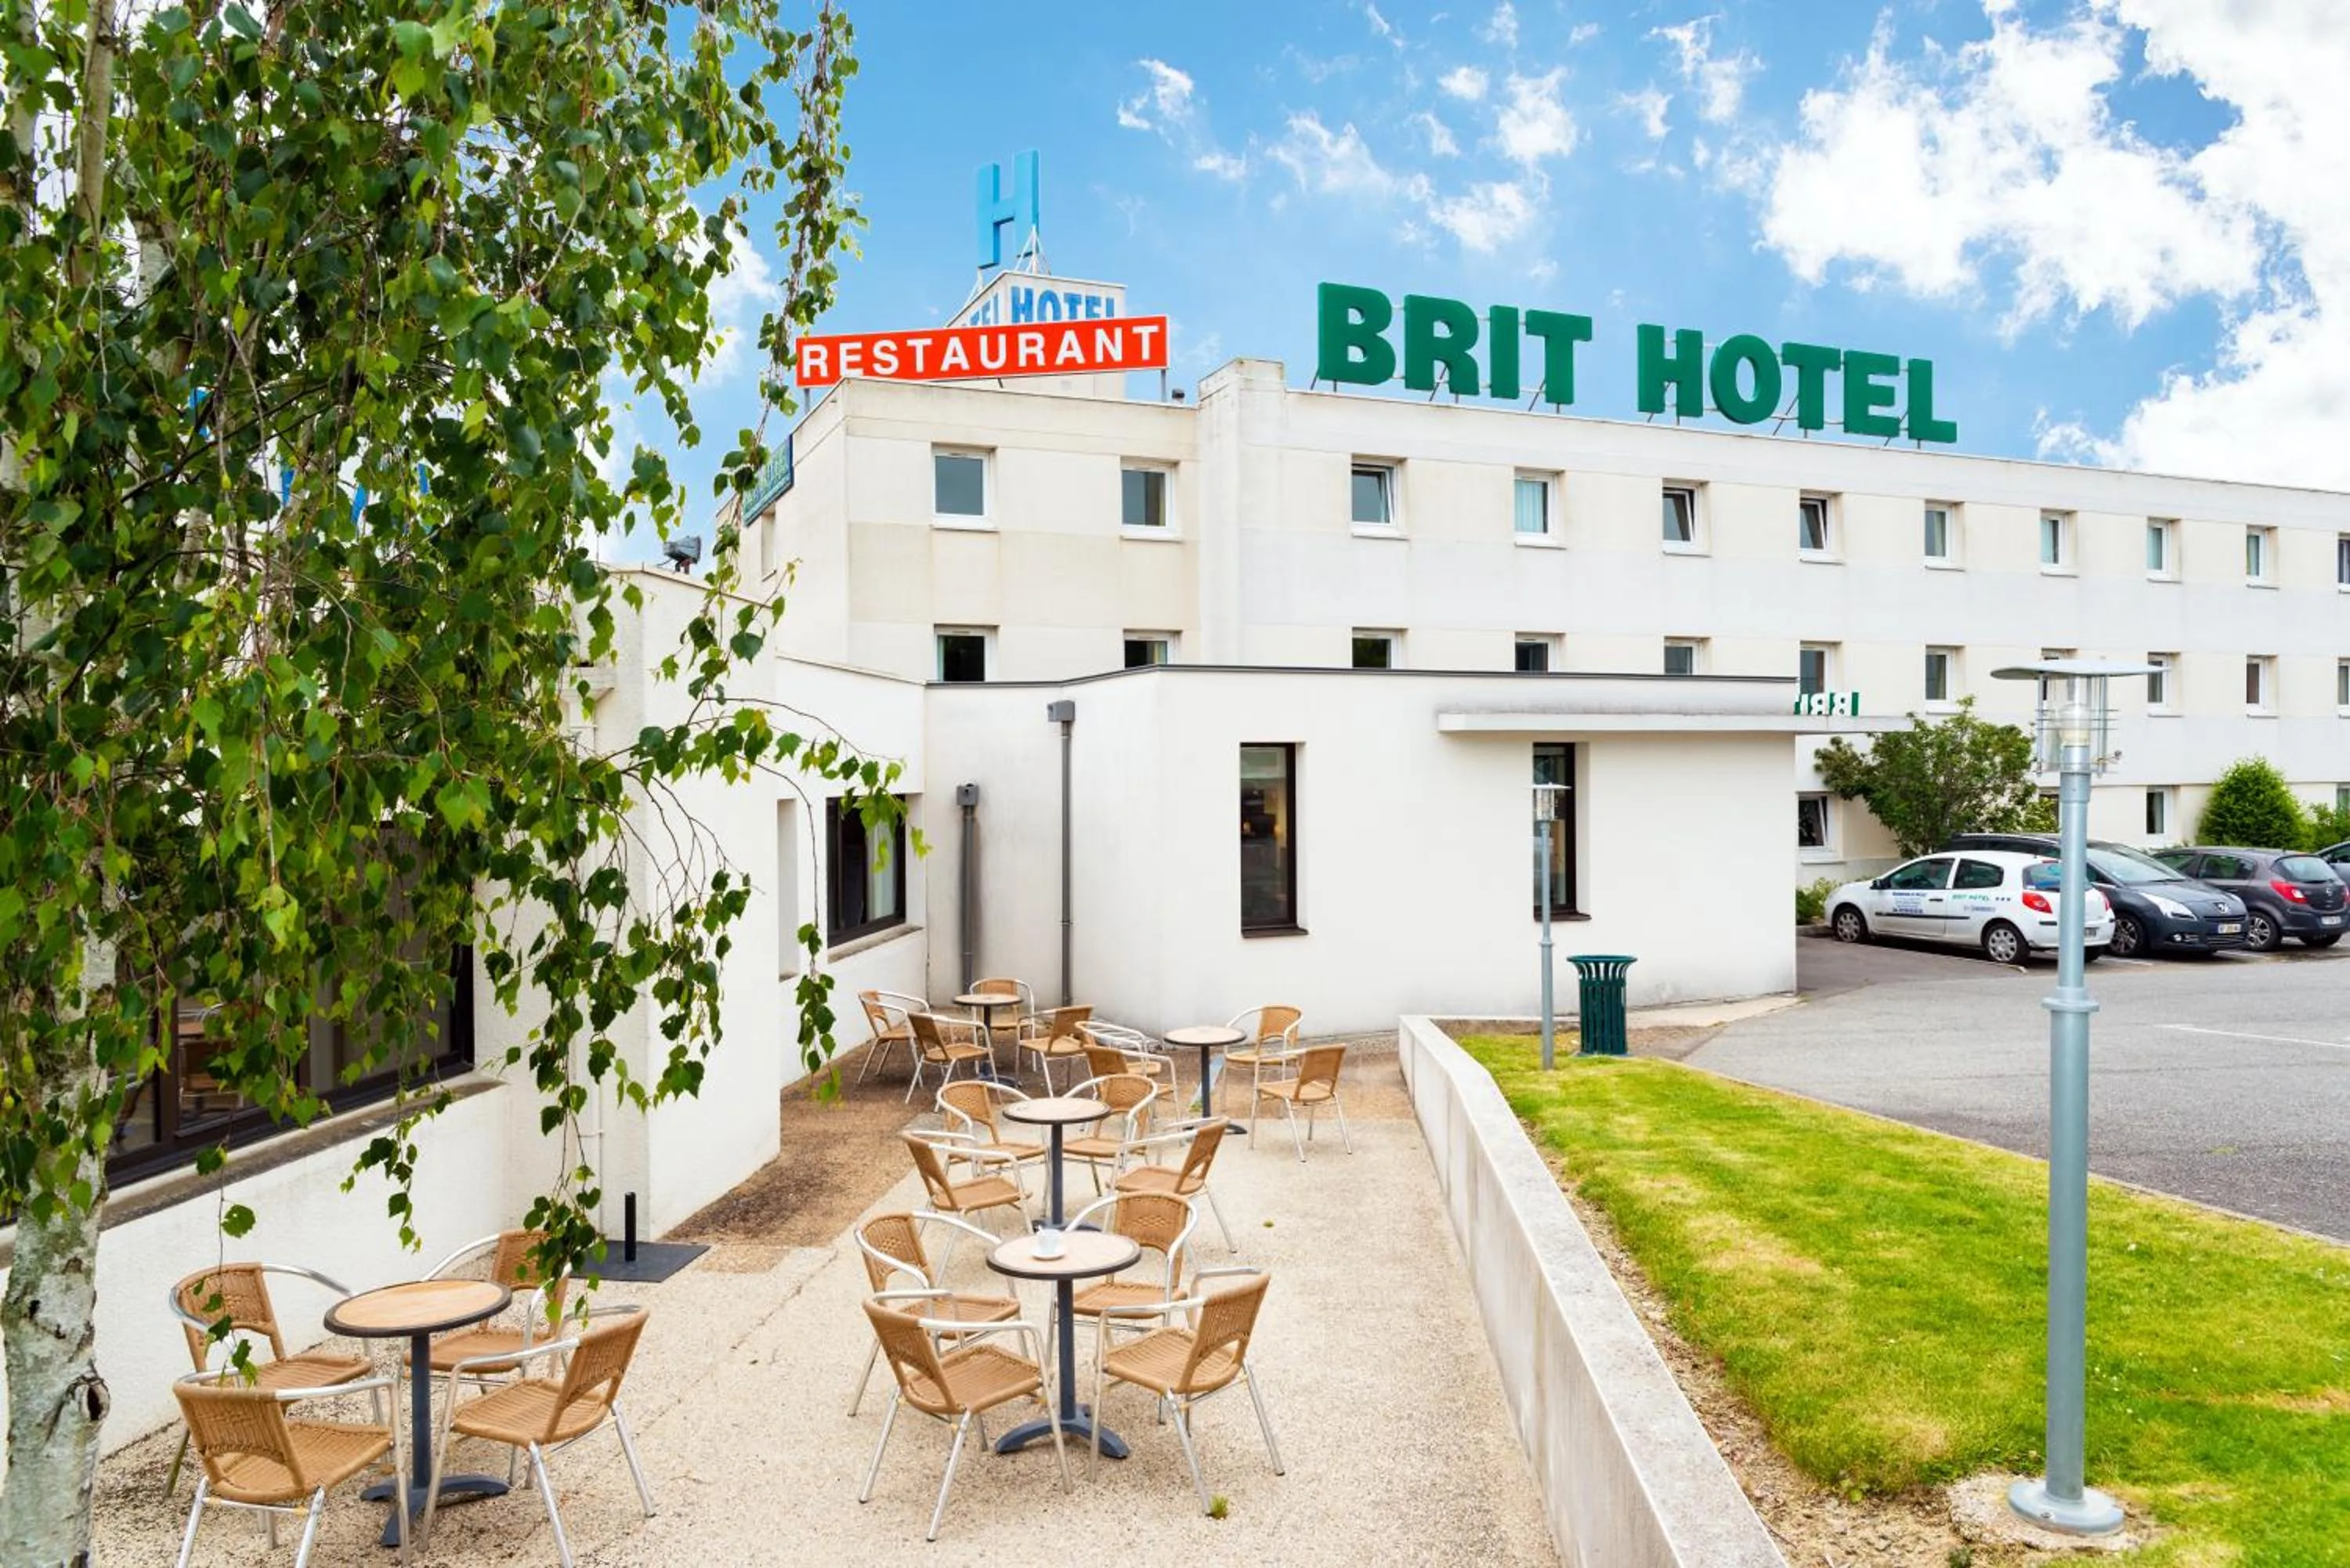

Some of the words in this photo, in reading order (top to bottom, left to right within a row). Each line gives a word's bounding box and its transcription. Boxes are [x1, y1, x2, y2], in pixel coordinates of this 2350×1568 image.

[977, 150, 1039, 269] H
[801, 325, 1159, 379] RESTAURANT
[1318, 282, 1592, 405] BRIT
[1637, 323, 1958, 443] HOTEL
